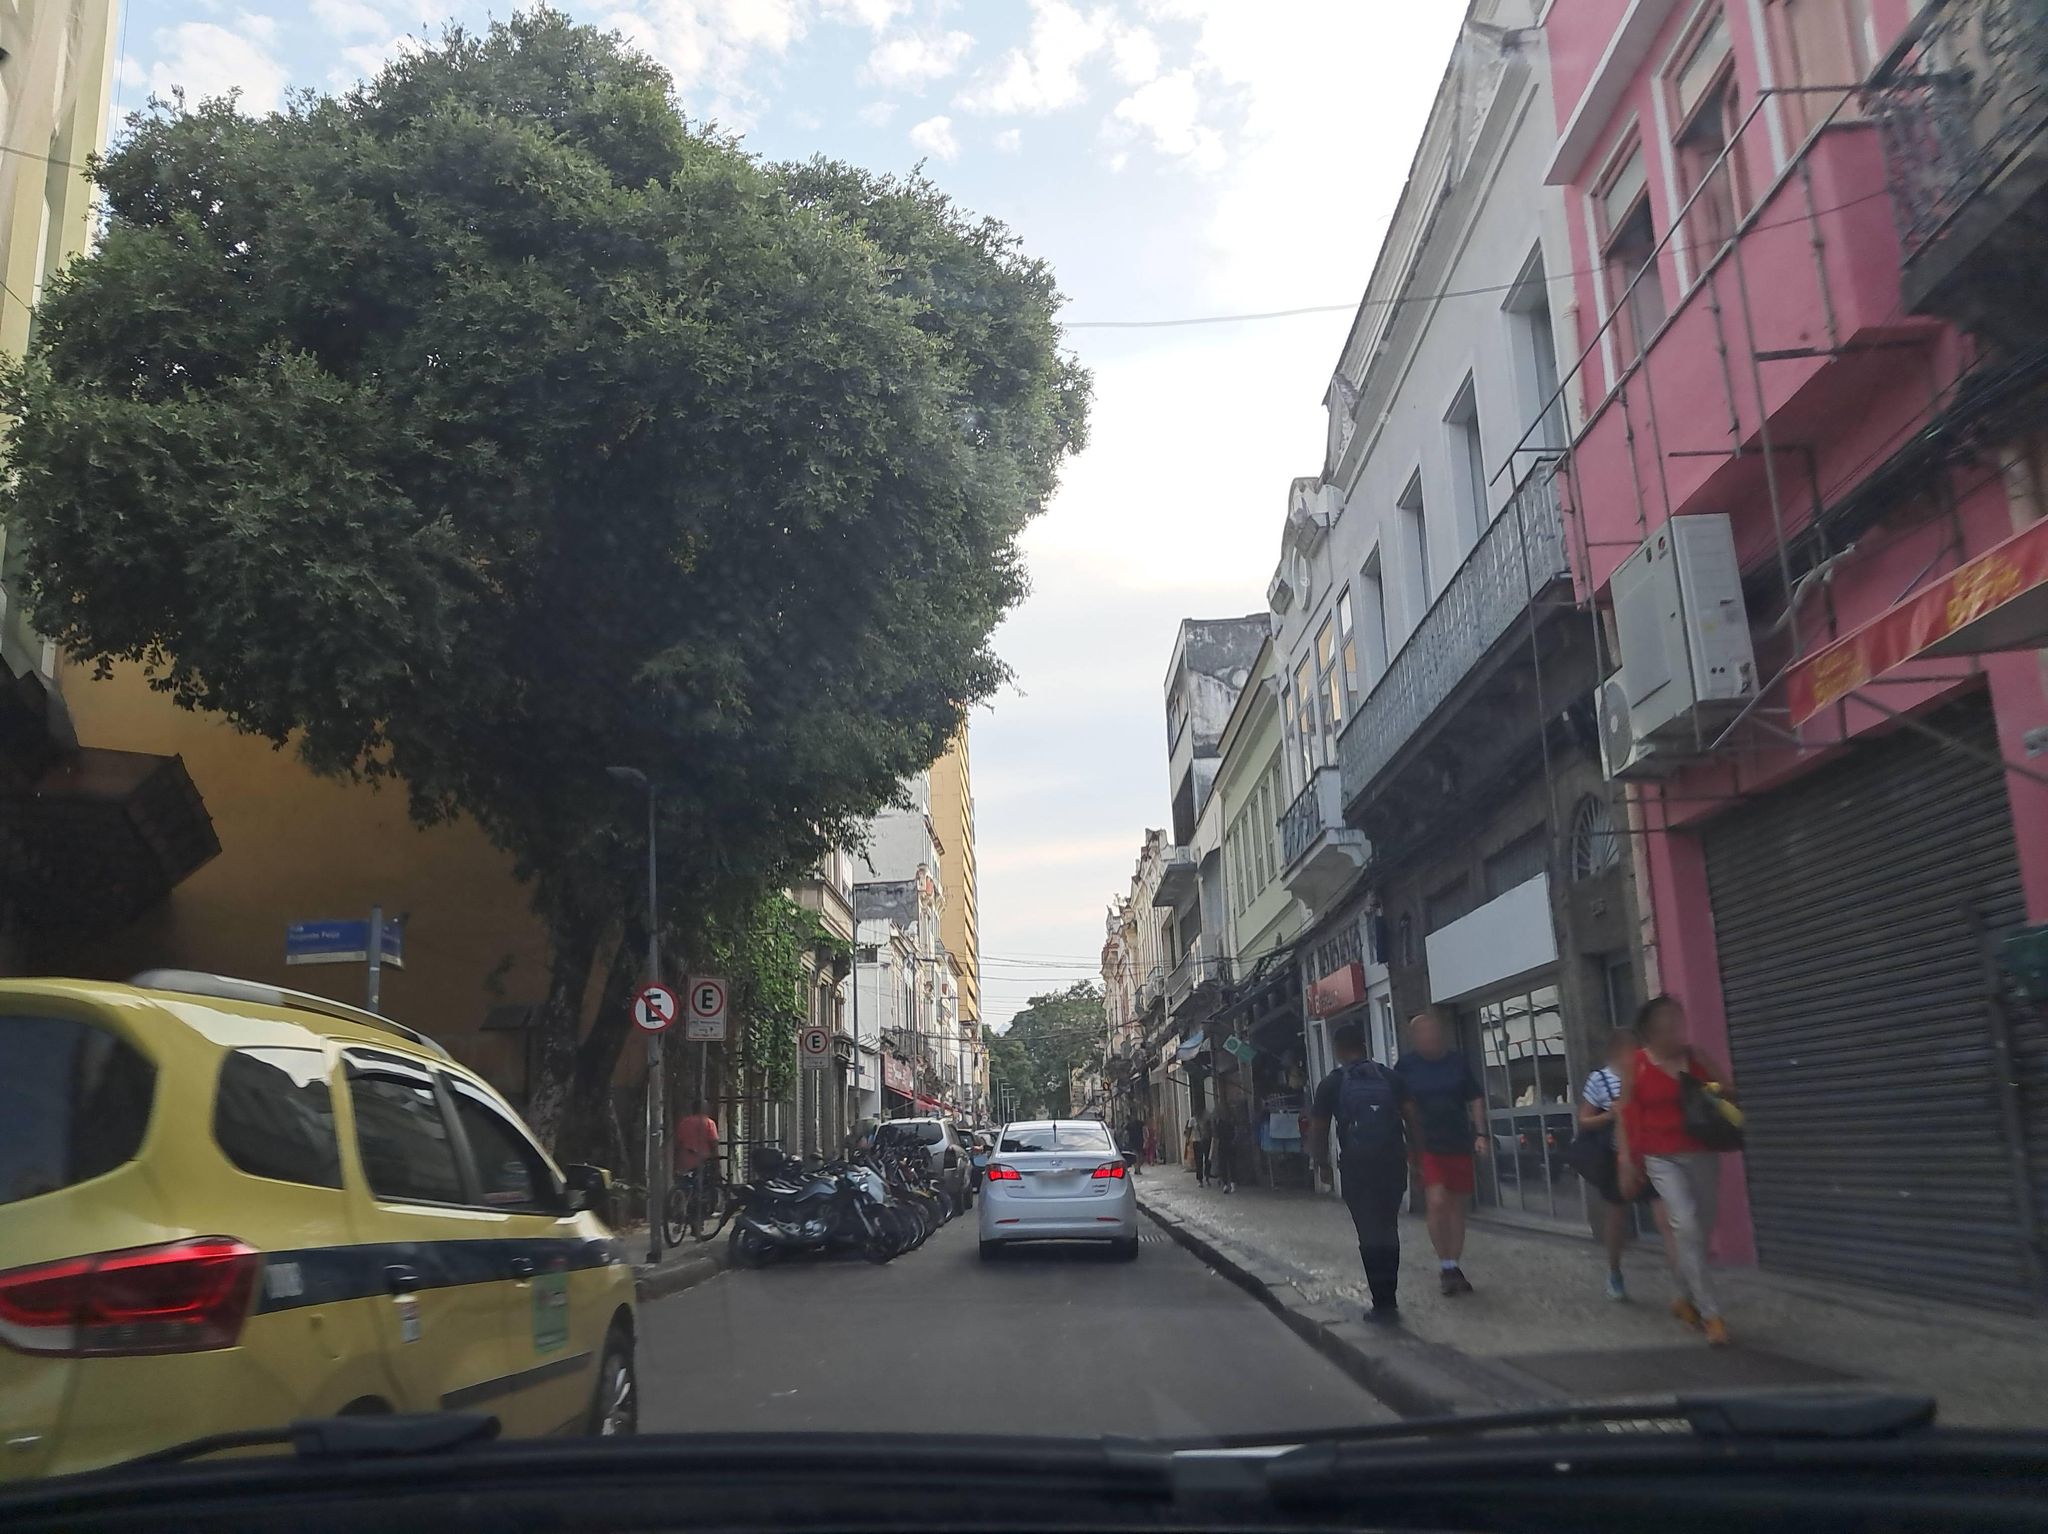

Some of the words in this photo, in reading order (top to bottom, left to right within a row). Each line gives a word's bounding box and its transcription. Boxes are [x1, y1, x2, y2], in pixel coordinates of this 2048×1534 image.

[646, 994, 661, 1022] E
[701, 989, 713, 1009] E
[812, 1035, 821, 1048] E
